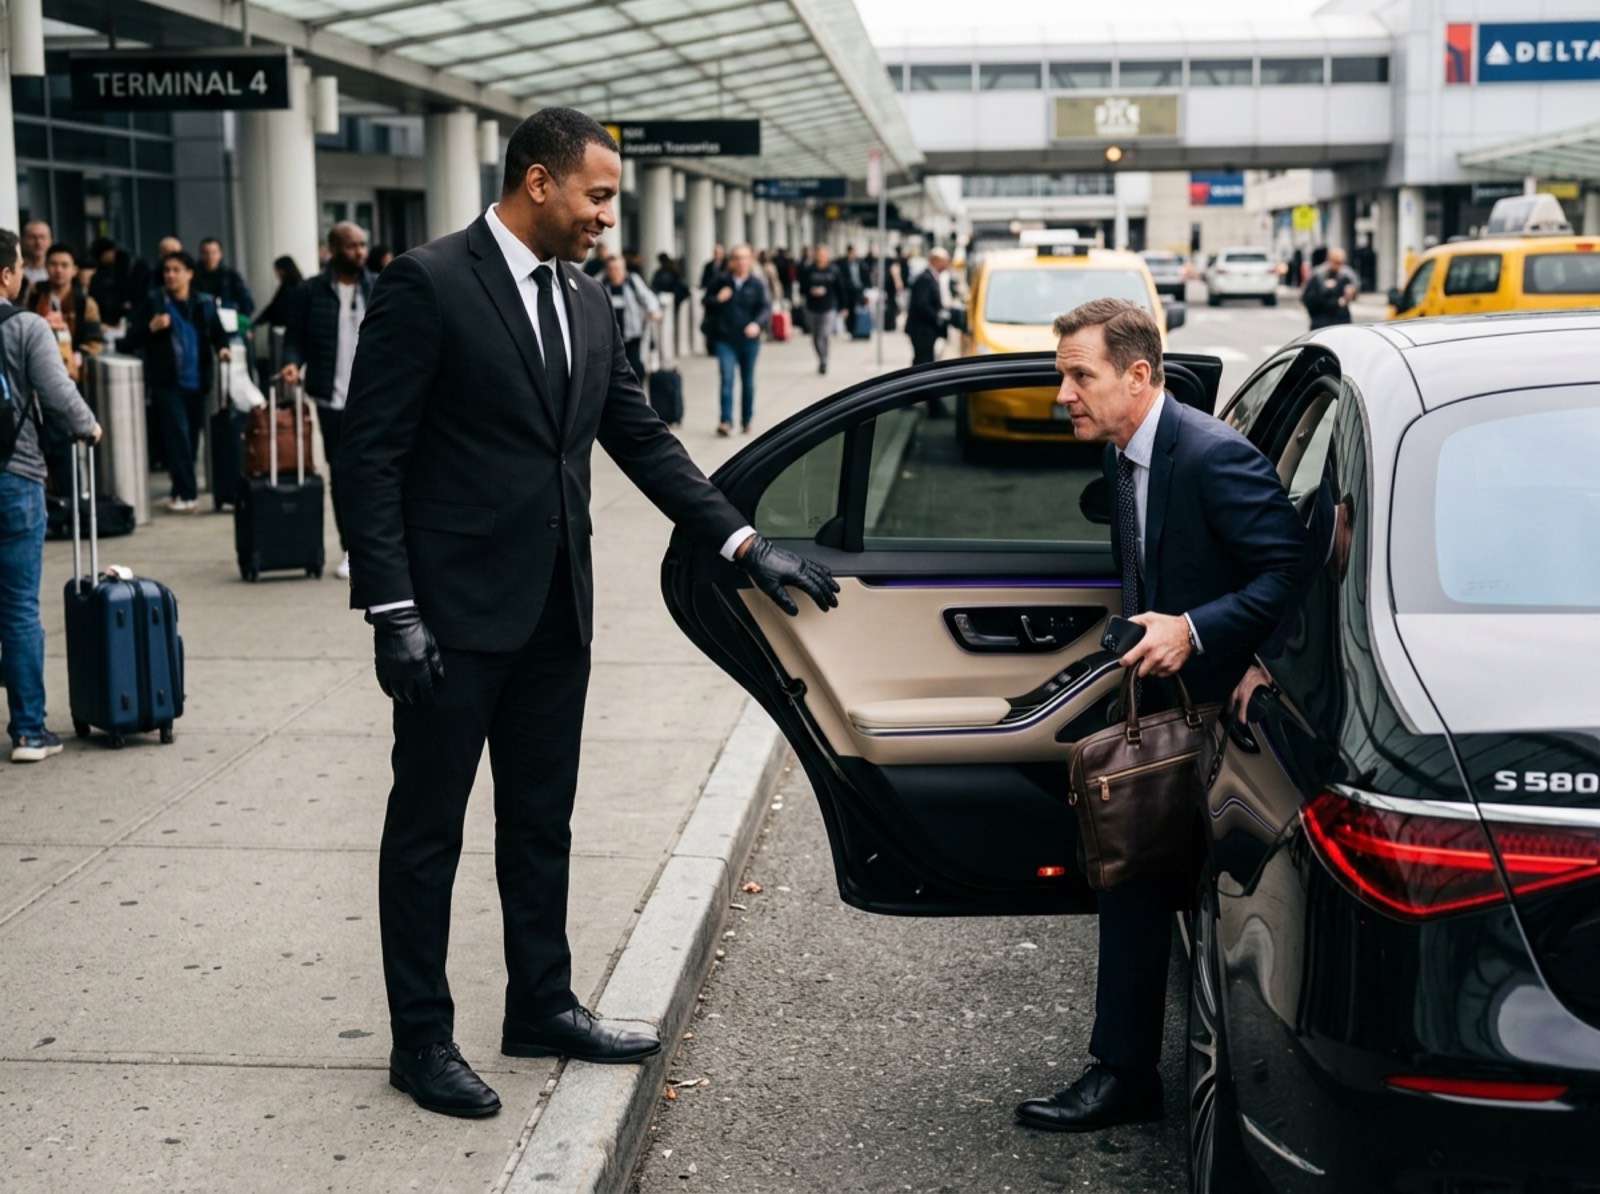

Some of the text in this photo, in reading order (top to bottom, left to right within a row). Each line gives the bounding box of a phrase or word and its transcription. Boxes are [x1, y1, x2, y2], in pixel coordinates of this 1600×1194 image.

[93, 70, 268, 97] TERMINAL 4
[1494, 770, 1599, 793] S 580
